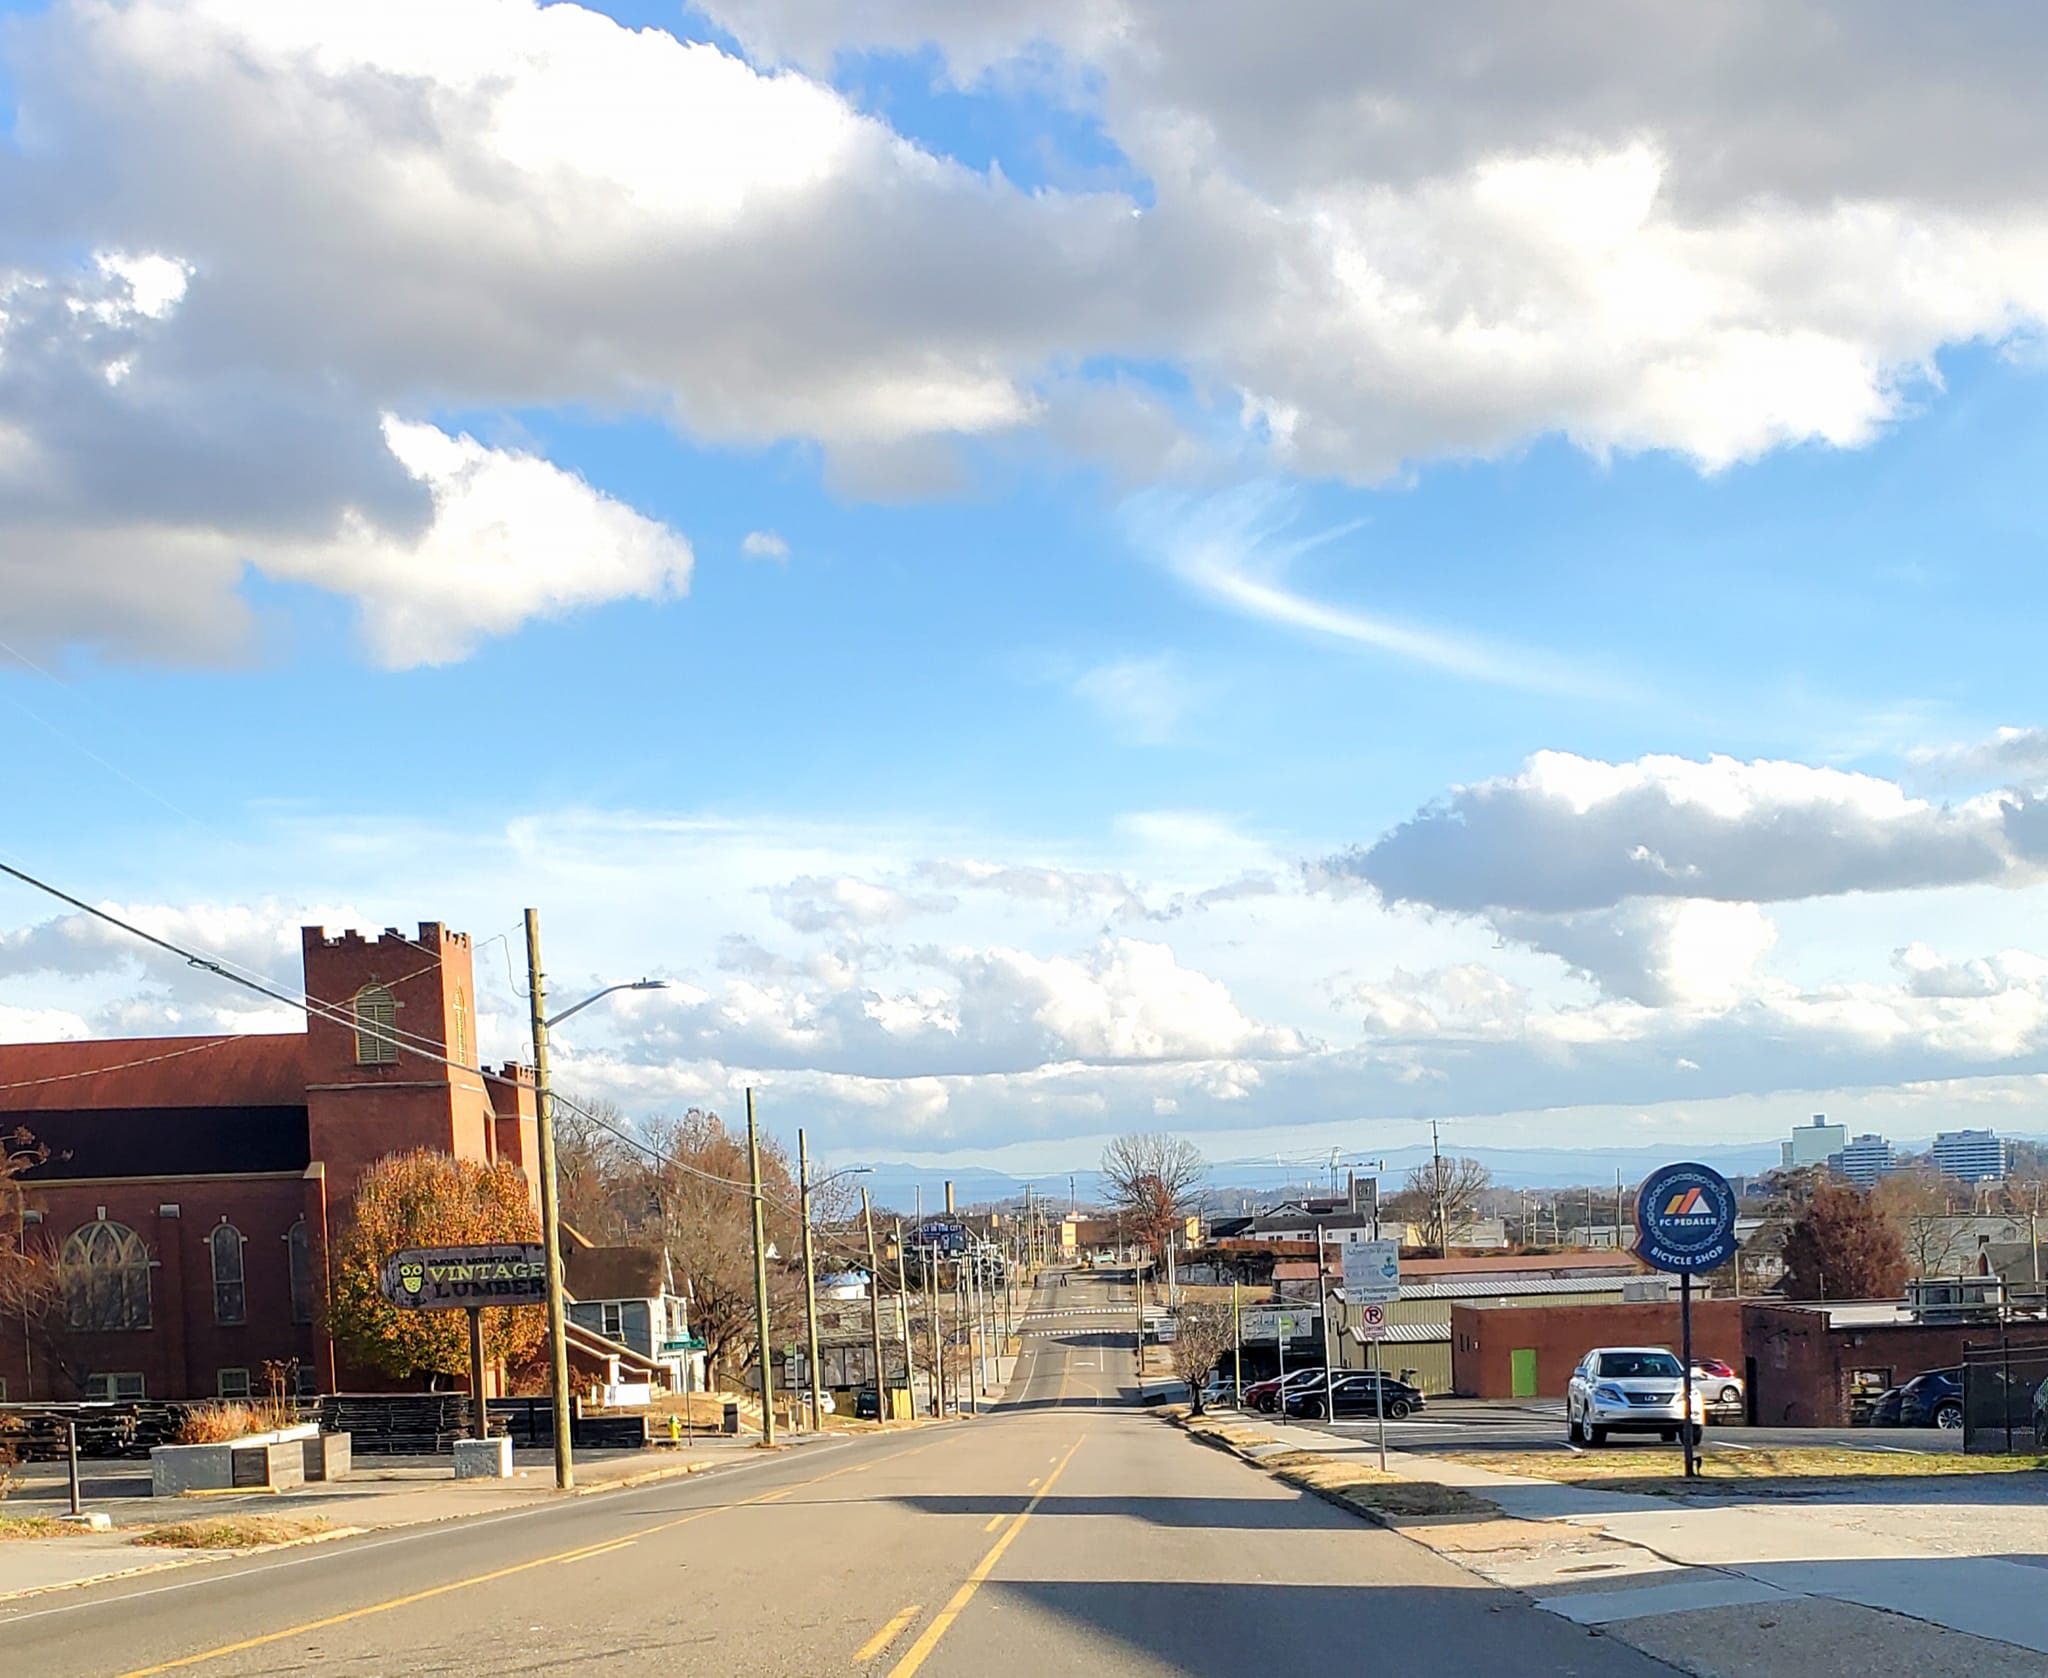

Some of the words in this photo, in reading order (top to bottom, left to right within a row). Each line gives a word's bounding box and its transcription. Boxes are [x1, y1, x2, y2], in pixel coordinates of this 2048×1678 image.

[1674, 1217, 1717, 1226] PEDALER
[465, 1255, 522, 1265] MOUNTAIN
[1650, 1246, 1692, 1265] BICYCLE
[1695, 1245, 1723, 1264] SHOP
[428, 1262, 546, 1282] VINTAGE
[434, 1279, 547, 1299] LUMBER
